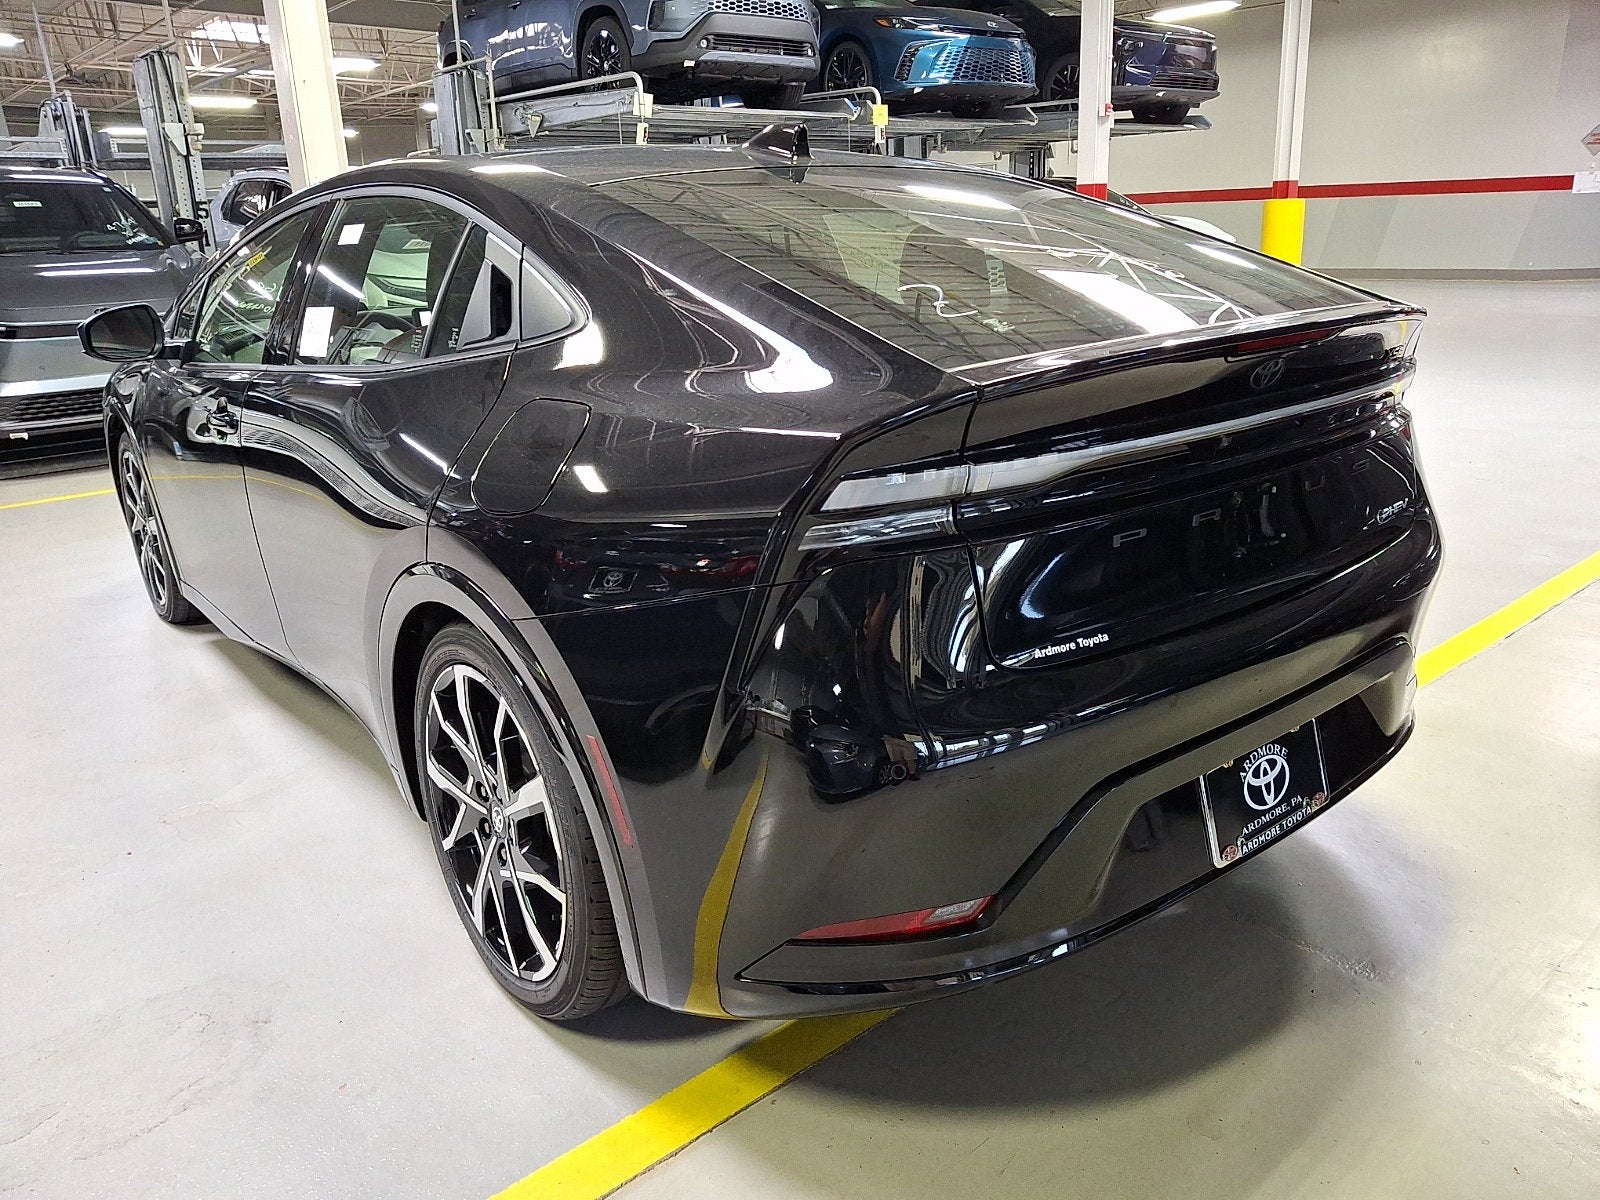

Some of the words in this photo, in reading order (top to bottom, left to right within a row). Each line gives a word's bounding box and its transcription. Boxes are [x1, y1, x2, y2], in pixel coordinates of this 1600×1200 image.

[1034, 642, 1076, 658] Ardmore
[1077, 633, 1109, 647] Toyota
[1240, 743, 1288, 782] ARDMORE
[1242, 801, 1290, 836] ARDMORE,
[1242, 825, 1281, 855] ARDMORE
[1281, 807, 1311, 829] TOYOTA
